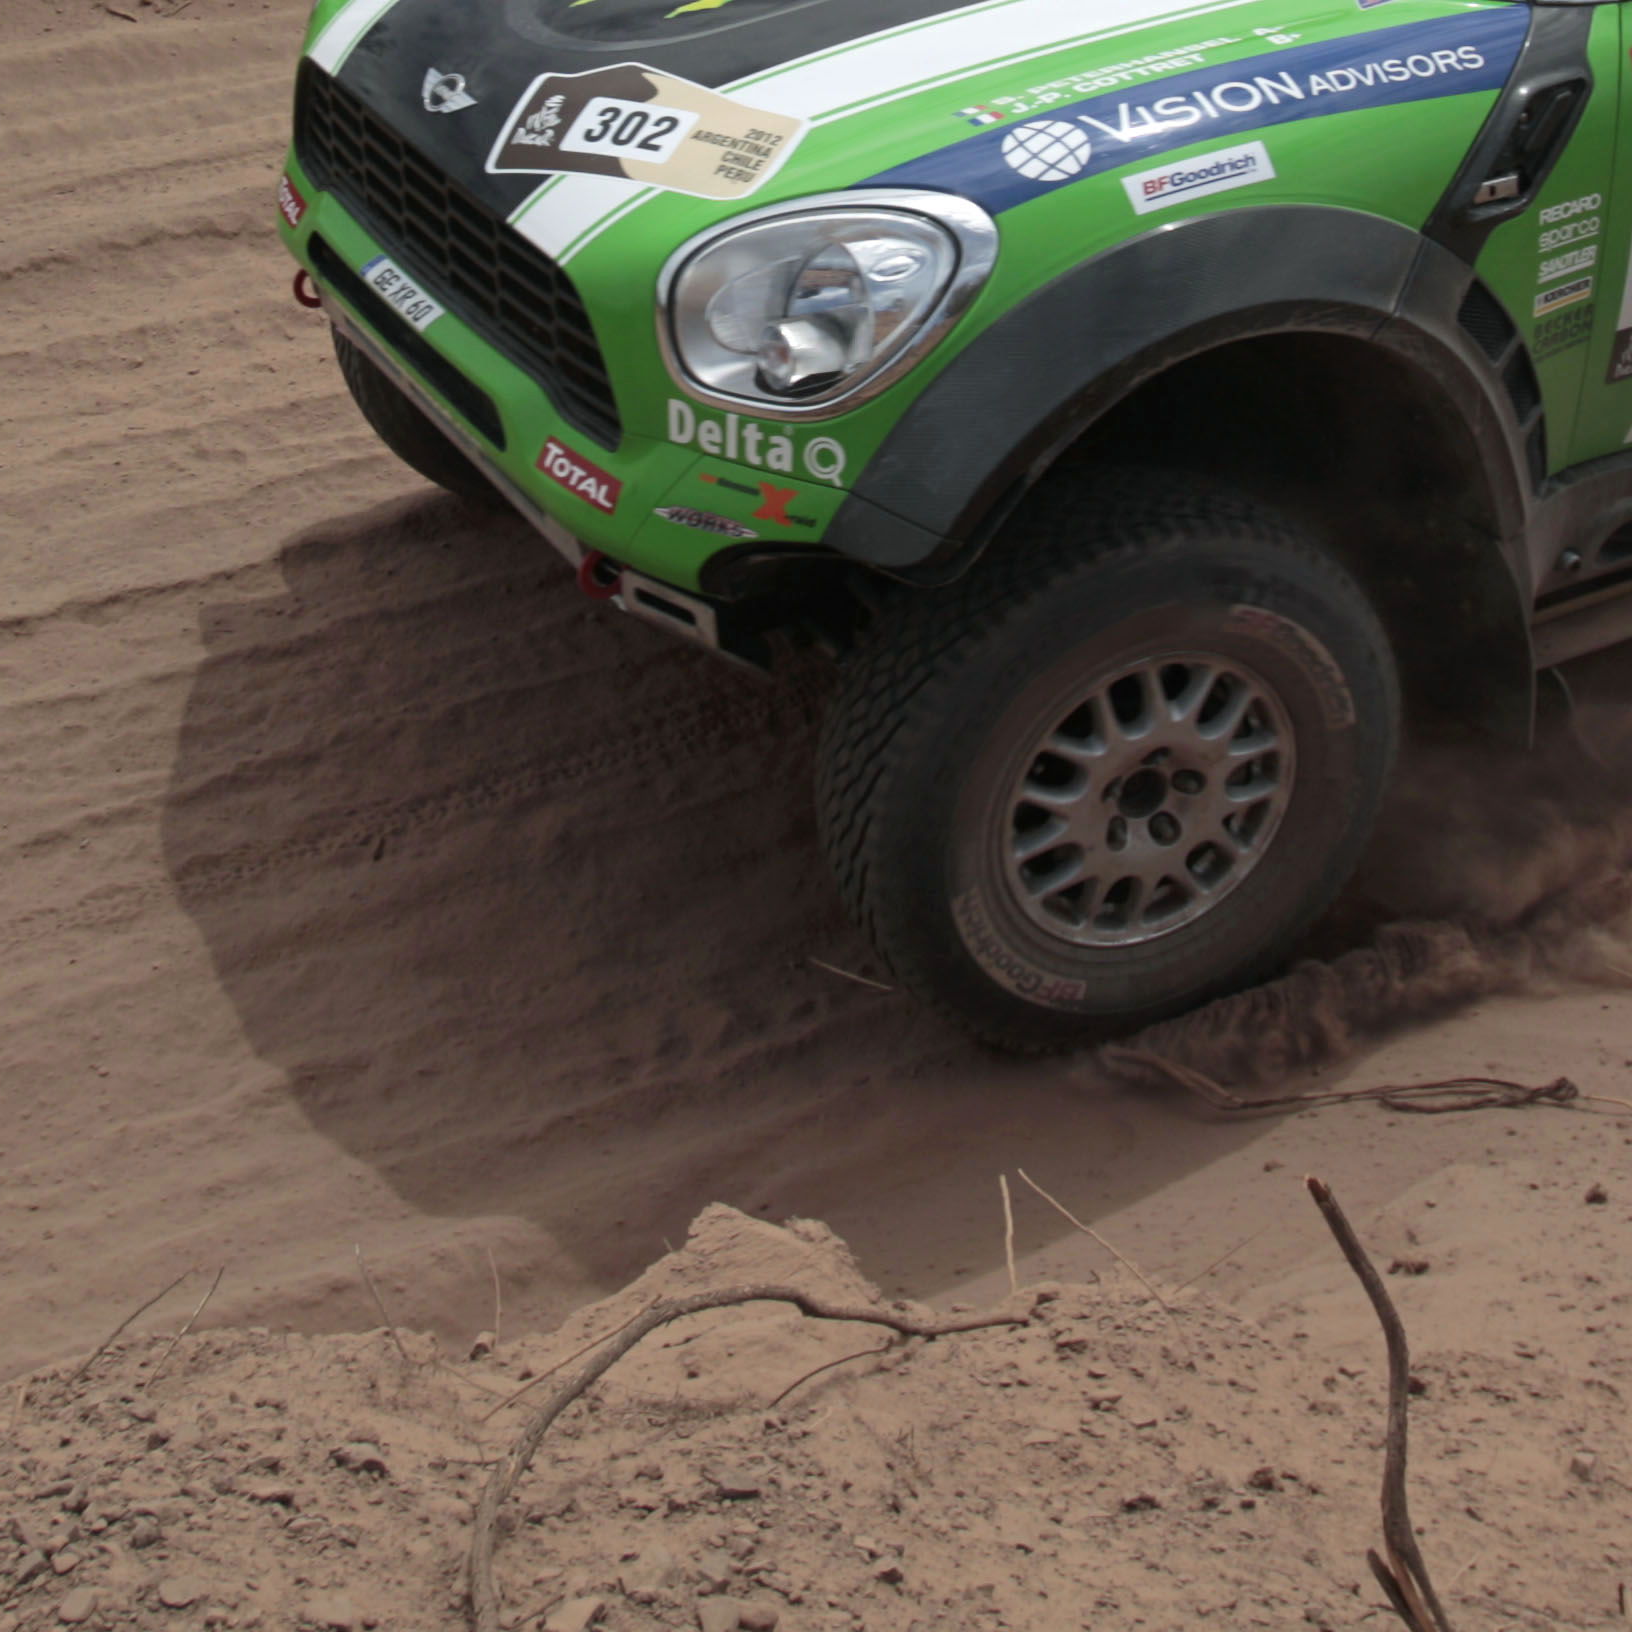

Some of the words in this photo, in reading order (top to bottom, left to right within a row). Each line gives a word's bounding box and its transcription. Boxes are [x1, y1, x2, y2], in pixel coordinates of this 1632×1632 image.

[1073, 53, 1206, 93] COTTRET
[1077, 71, 1307, 143] VISION
[1308, 45, 1485, 97] ADVISORS
[583, 106, 680, 152] 302
[689, 129, 774, 158] ARGENTINA
[744, 128, 784, 147] 2012
[713, 163, 757, 184] PERU
[721, 150, 766, 170] CHILE
[1143, 152, 1257, 196] BFGoodrich
[1539, 193, 1602, 226] RECARO
[406, 300, 434, 323] 60
[668, 398, 794, 472] Delta
[543, 442, 614, 509] TOTAL
